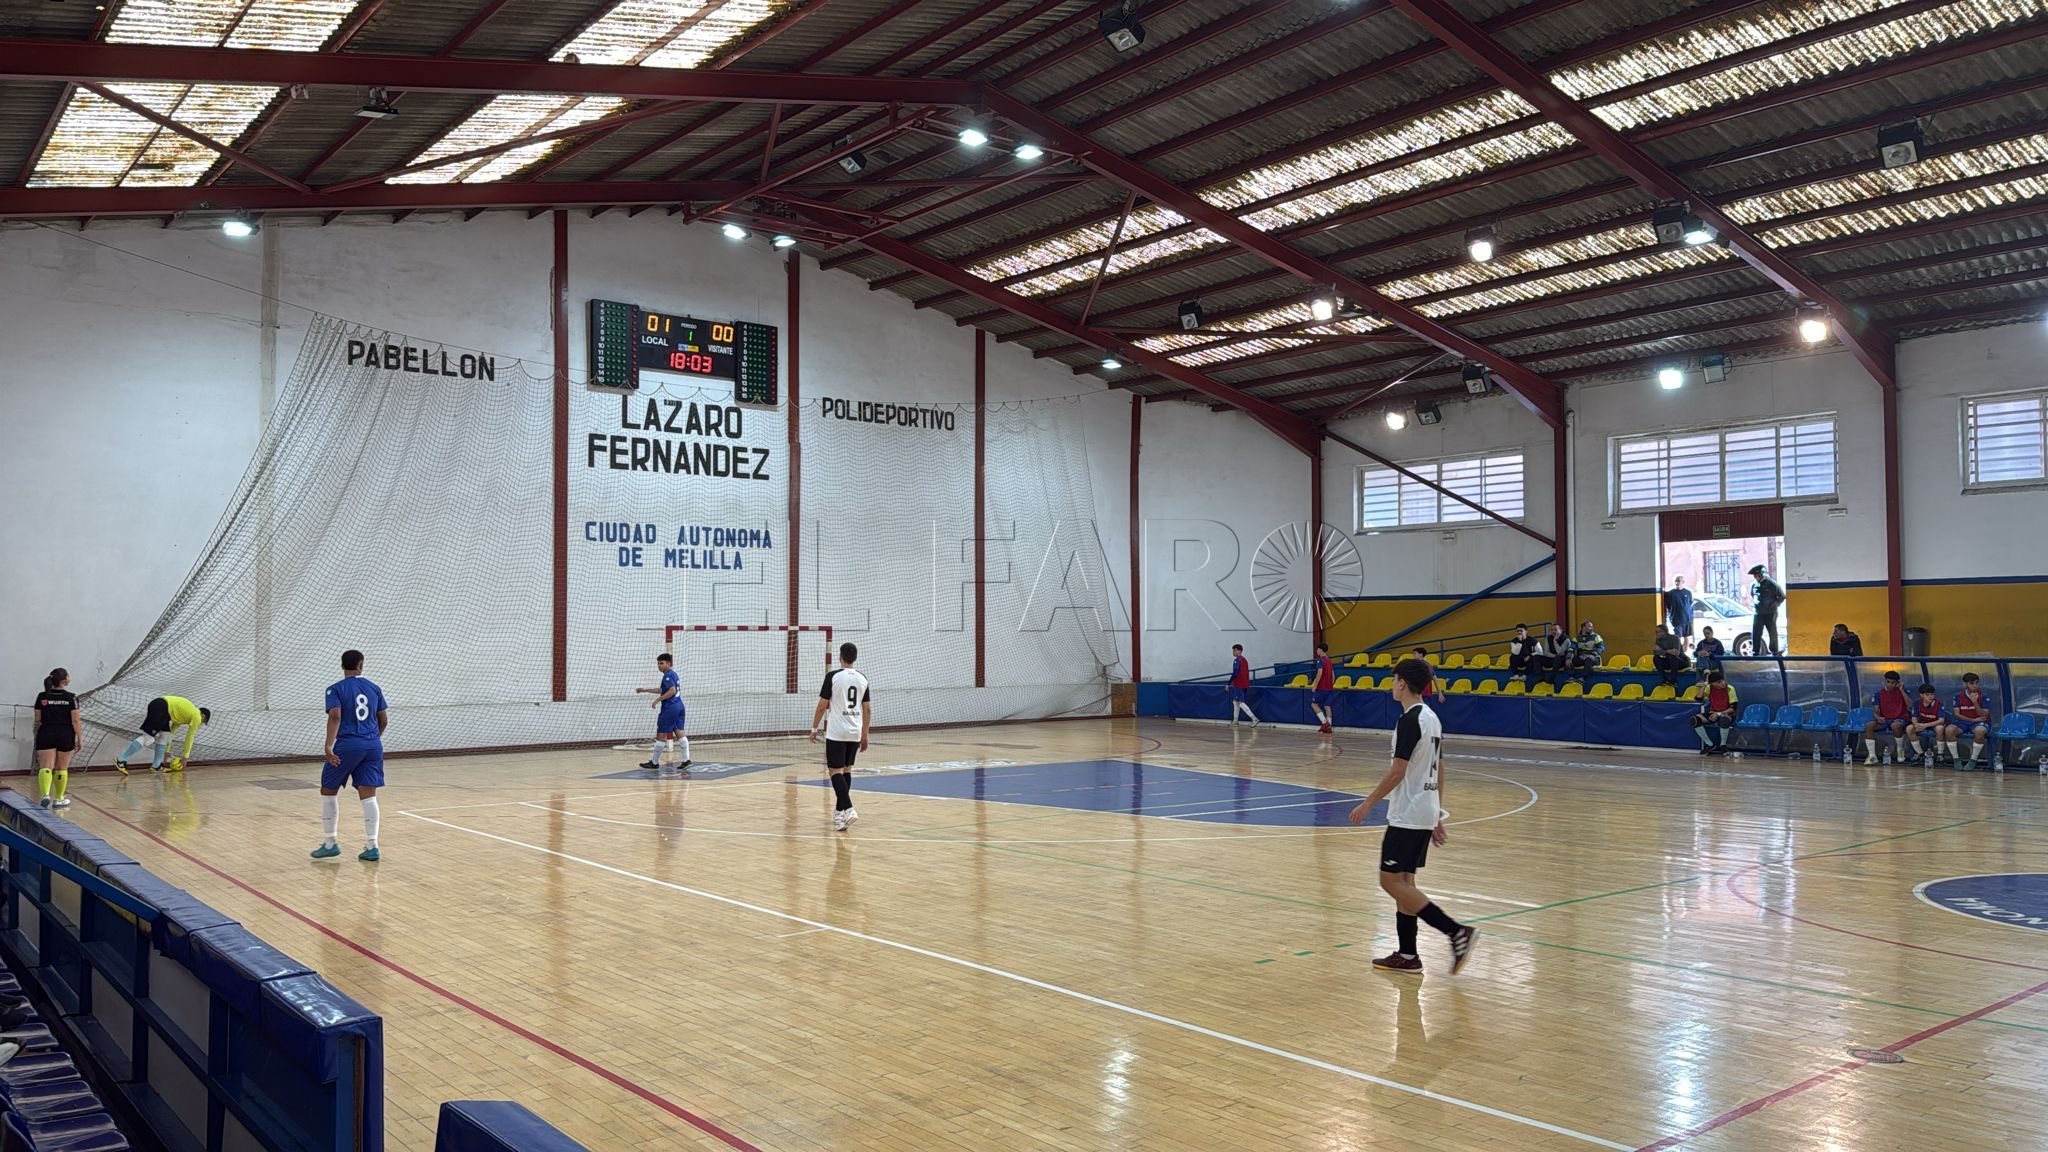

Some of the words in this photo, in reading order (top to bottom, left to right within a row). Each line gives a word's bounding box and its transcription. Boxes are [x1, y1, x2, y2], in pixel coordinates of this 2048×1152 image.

[648, 315, 671, 333] 01
[712, 324, 734, 343] 00
[641, 335, 669, 347] LOCAL
[708, 344, 734, 355] VISITANTE
[347, 340, 495, 381] PABELLON
[670, 352, 712, 374] 18:03
[622, 395, 742, 439] LAZARO
[822, 397, 955, 431] POLIDEPORTIVO
[588, 433, 769, 480] FERNANDEZ
[585, 521, 656, 543] CIUDAD
[677, 525, 772, 548] AUTONOMA
[618, 547, 643, 567] DE
[664, 548, 743, 570] MELILLA
[356, 694, 369, 721] 8
[848, 686, 857, 709] 9
